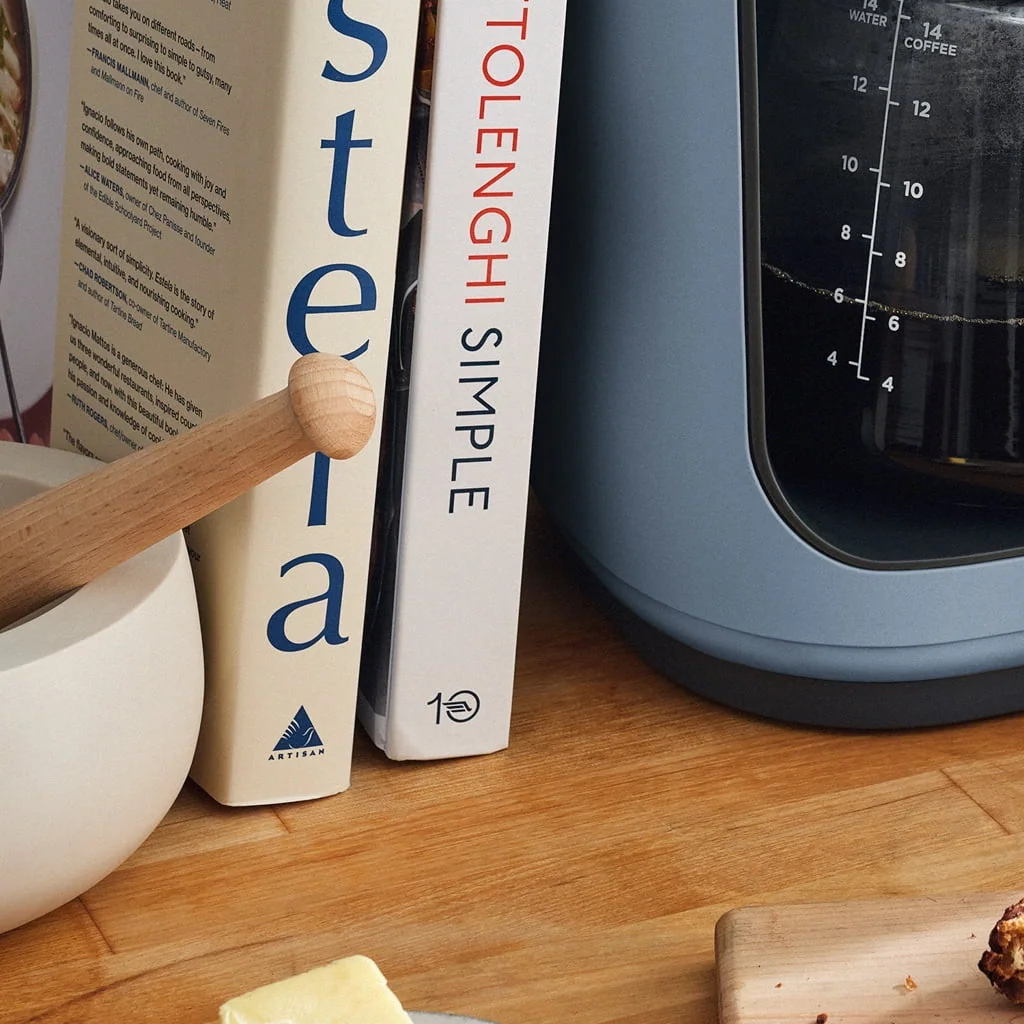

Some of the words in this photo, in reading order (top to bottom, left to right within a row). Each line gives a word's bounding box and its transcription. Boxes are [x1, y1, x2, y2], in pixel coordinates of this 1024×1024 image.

[849, 9, 888, 27] WATER
[151, 18, 176, 42] different
[178, 35, 195, 52] roads
[201, 46, 215, 63] from
[923, 22, 942, 40] 14
[88, 22, 104, 40] times
[120, 42, 136, 58] once.
[140, 51, 153, 67] love
[154, 59, 165, 74] this
[89, 6, 120, 32] comforting
[129, 28, 159, 54] surprising
[168, 49, 188, 68] simple
[196, 66, 214, 85] gutsy,
[215, 77, 232, 95] many
[904, 36, 958, 57] COFFEE
[852, 75, 867, 93] 12
[116, 62, 150, 90] MALLMANN,
[151, 82, 163, 96] chef
[174, 97, 192, 112] author
[199, 110, 216, 127] Seven
[216, 120, 230, 136] Fires
[912, 100, 931, 118] 12
[105, 115, 125, 136] follows
[149, 145, 164, 162] path,
[166, 155, 190, 178] cooking
[191, 170, 204, 184] with
[82, 123, 114, 151] confidence,
[115, 144, 152, 174] approaching
[153, 164, 167, 182] food
[168, 174, 182, 191] from
[191, 190, 231, 224] perspectives,
[841, 155, 859, 173] 10
[81, 141, 101, 162] making
[102, 152, 115, 169] bold
[115, 163, 148, 190] statements
[160, 191, 189, 218] remaining
[903, 180, 924, 199] 10
[101, 175, 124, 199] WATERS,
[125, 189, 142, 208] owner
[149, 205, 162, 222] Chez
[163, 214, 183, 235] Panisse
[195, 234, 215, 256] founder
[841, 224, 851, 241] 8
[81, 224, 106, 248] visionary
[106, 241, 118, 256] sort
[126, 254, 154, 280] simplicity.
[155, 272, 173, 292] Estela
[191, 298, 206, 316] story
[895, 251, 907, 268] 8
[75, 239, 102, 266] elemental,
[104, 256, 126, 283] intuitive,
[140, 283, 170, 312] nourishing
[834, 287, 845, 304] 6
[128, 298, 152, 320] co-owner
[160, 317, 177, 338] Tartine
[178, 330, 211, 362] Manufactory
[888, 315, 900, 332] 6
[827, 350, 838, 367] 4
[91, 330, 110, 352] Mattos
[121, 354, 148, 380] generous
[186, 400, 202, 418] given
[881, 376, 894, 392] 4
[448, 326, 503, 514] SIMPLE
[268, 749, 325, 761] ARTISAN
